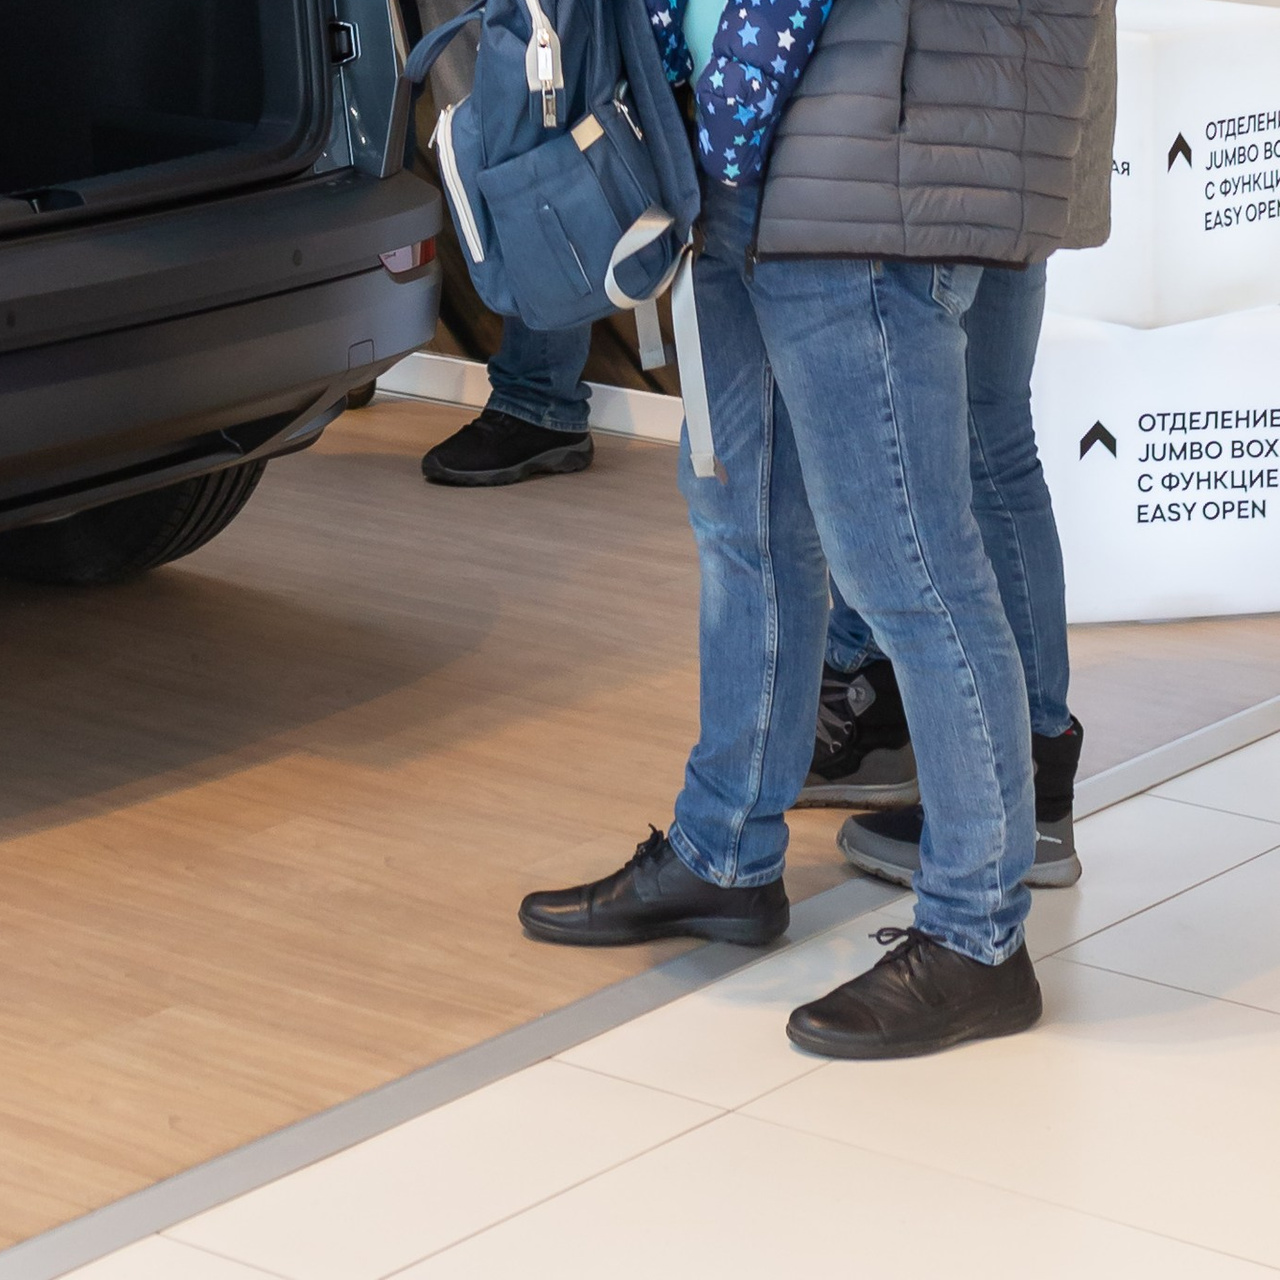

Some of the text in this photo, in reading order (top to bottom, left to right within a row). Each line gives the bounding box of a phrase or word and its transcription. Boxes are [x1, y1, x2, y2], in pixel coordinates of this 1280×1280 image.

[1205, 143, 1259, 171] JUMBO
[1204, 181, 1216, 200] С
[1204, 205, 1243, 231] EASY
[1138, 408, 1280, 435] ОТДЕЛЕНИЕ
[1138, 438, 1279, 463] JUMBO BOX
[1137, 473, 1154, 493] С
[1137, 499, 1266, 524] EASY OPEN
